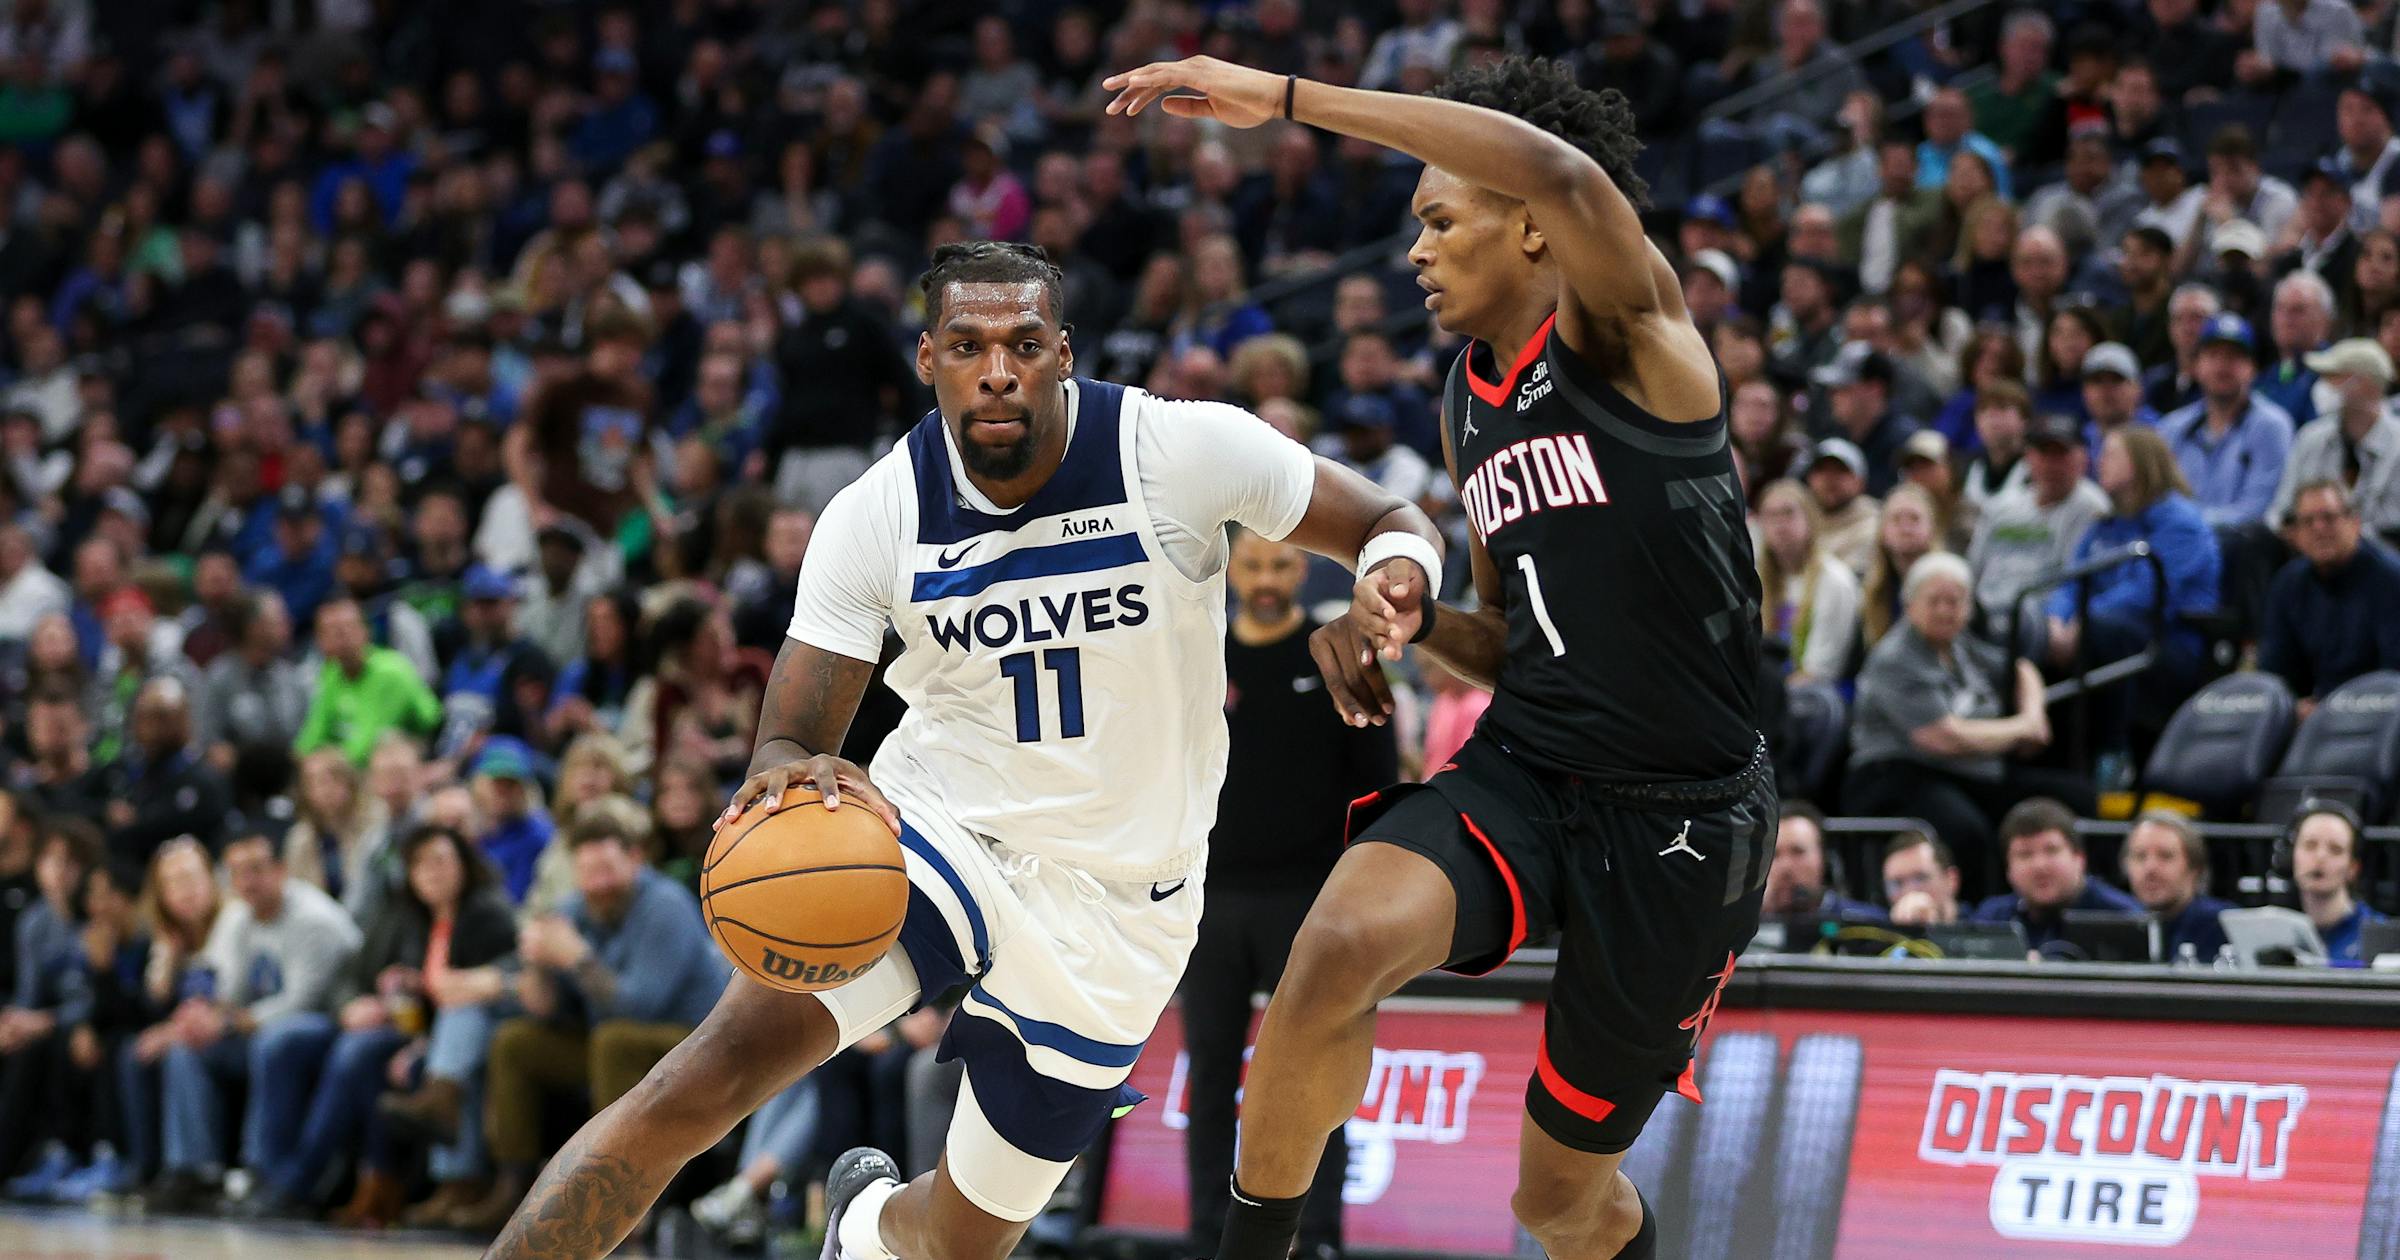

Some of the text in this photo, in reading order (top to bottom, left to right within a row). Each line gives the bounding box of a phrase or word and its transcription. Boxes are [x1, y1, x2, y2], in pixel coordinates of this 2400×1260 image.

[1460, 432, 1610, 548] OUSTON
[925, 583, 1150, 655] WOLVES
[1516, 552, 1567, 658] 1
[999, 646, 1086, 744] 11
[1922, 1071, 2302, 1177] DISCOUNT
[2016, 1175, 2170, 1227] TIRE
